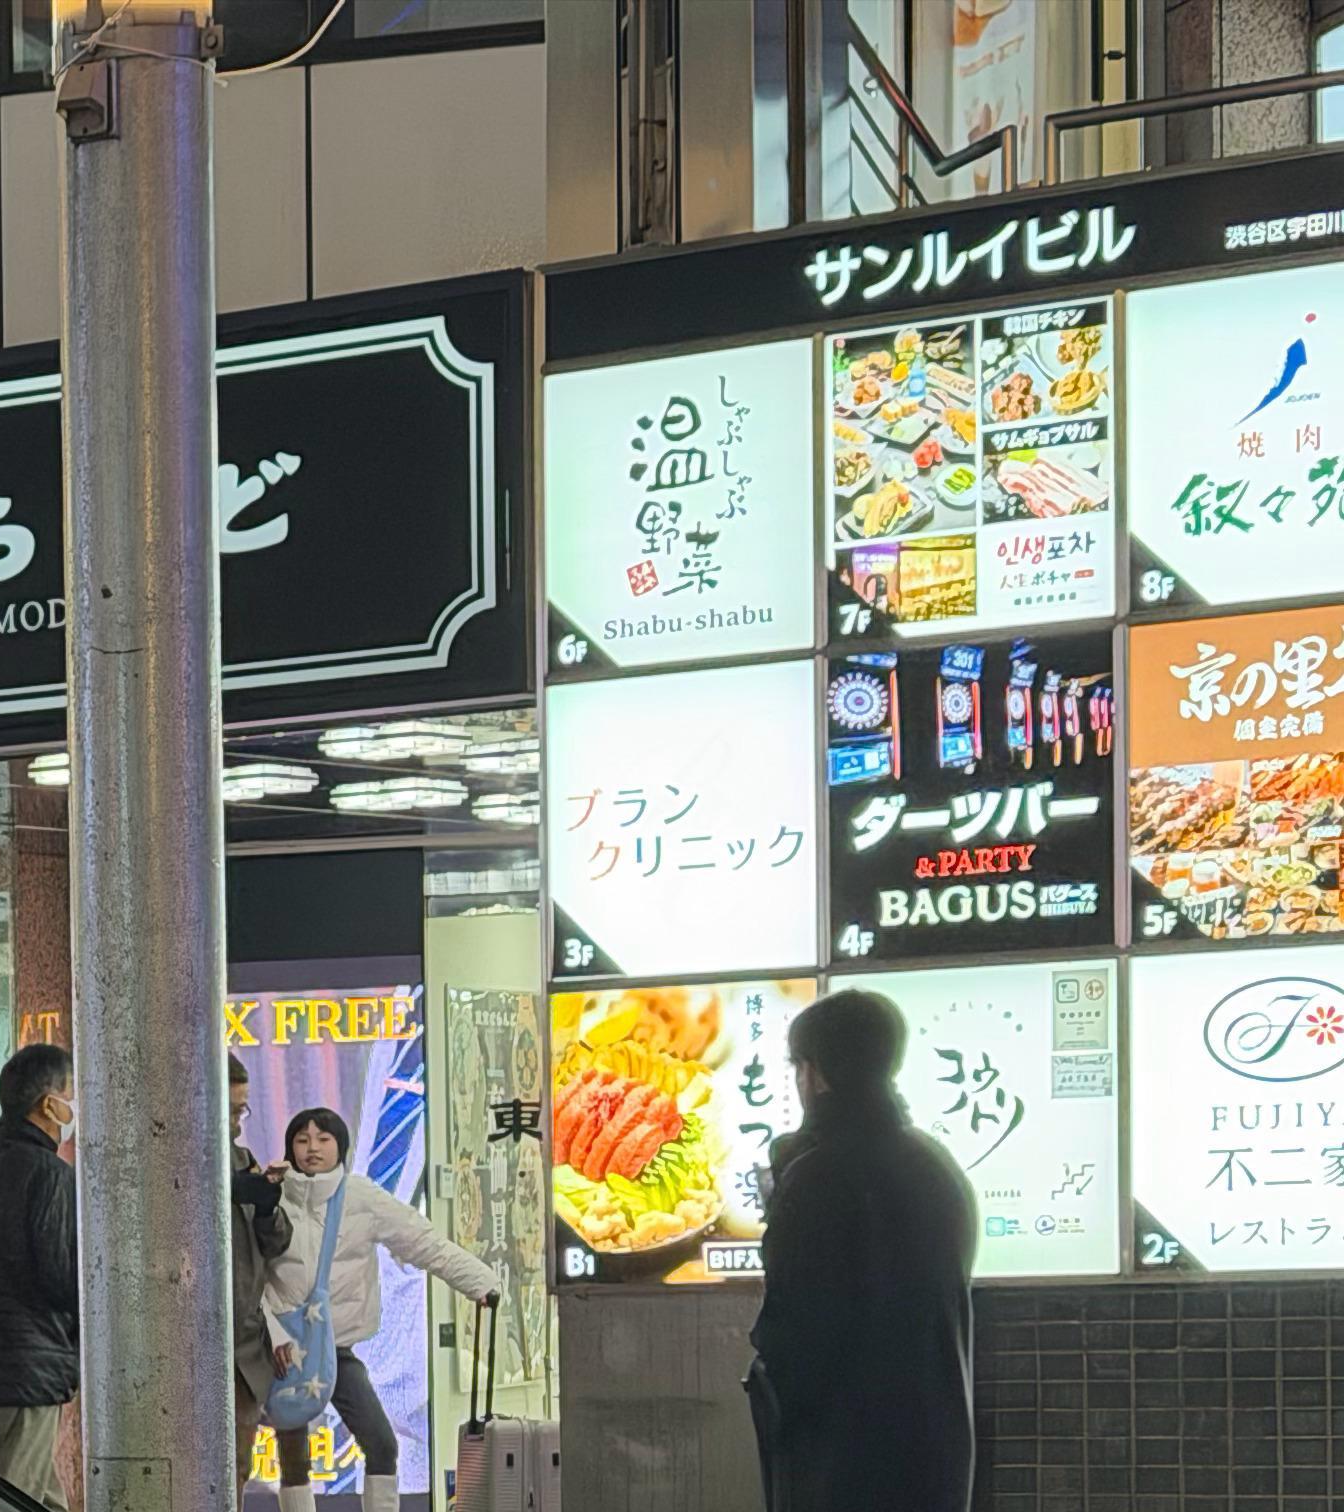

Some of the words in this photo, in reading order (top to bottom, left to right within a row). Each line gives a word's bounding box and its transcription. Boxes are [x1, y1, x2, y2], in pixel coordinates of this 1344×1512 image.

[805, 207, 1136, 306] サンルイビル
[1237, 424, 1322, 459] 焼肉
[629, 396, 722, 596] 温野菜
[1141, 568, 1175, 602] 8F
[603, 606, 774, 641] Shabu-shabu
[839, 603, 872, 635] 7F
[558, 635, 587, 664] 6F
[566, 784, 699, 832] ブラン
[852, 781, 1100, 852] ダーツバー
[587, 825, 804, 881] クリニック
[878, 881, 1037, 927] BAGUS
[1143, 905, 1177, 937] 5F
[564, 938, 593, 968] 3F
[838, 925, 874, 956] 4F
[272, 996, 416, 1046] FREE
[487, 1099, 544, 1144] 東
[1212, 1102, 1344, 1131] FUJIY
[1210, 1216, 1344, 1246] レストラ
[564, 1247, 596, 1277] B1
[1143, 1232, 1179, 1265] 2F
